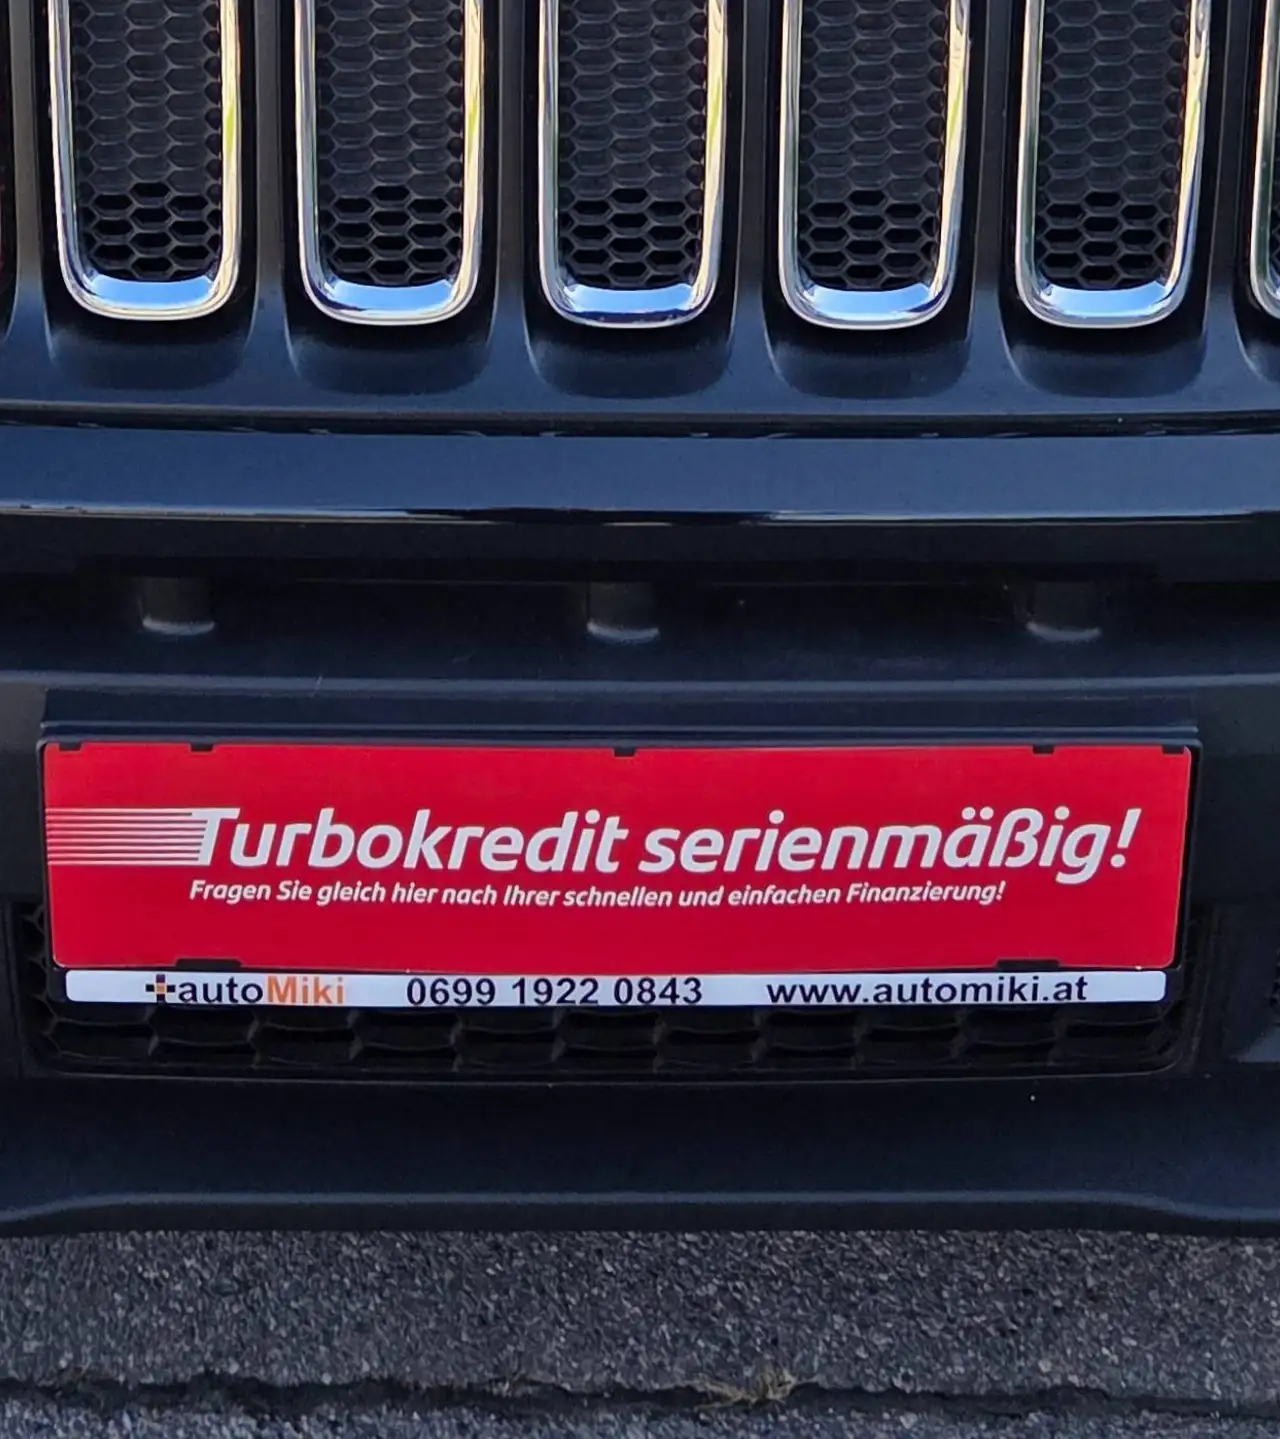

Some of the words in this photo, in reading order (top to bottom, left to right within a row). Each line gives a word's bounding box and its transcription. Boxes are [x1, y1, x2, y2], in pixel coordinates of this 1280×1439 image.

[190, 807, 629, 873] Turbokredit
[637, 806, 1141, 884] serienmäßig!
[189, 880, 271, 904] Fragen
[276, 880, 312, 901] Sie
[317, 880, 386, 906] gleich
[391, 882, 438, 903] hier
[441, 884, 497, 905] nach
[503, 885, 560, 906] Ihrer
[563, 886, 672, 907] schnellen
[678, 886, 725, 906] und
[728, 885, 841, 906] einfachen
[846, 881, 1006, 906] Finanzierung!
[407, 977, 496, 1005] 0699
[511, 977, 599, 1005] 1922
[613, 977, 703, 1005] 0843
[766, 976, 1088, 1003] www.automiki.at
